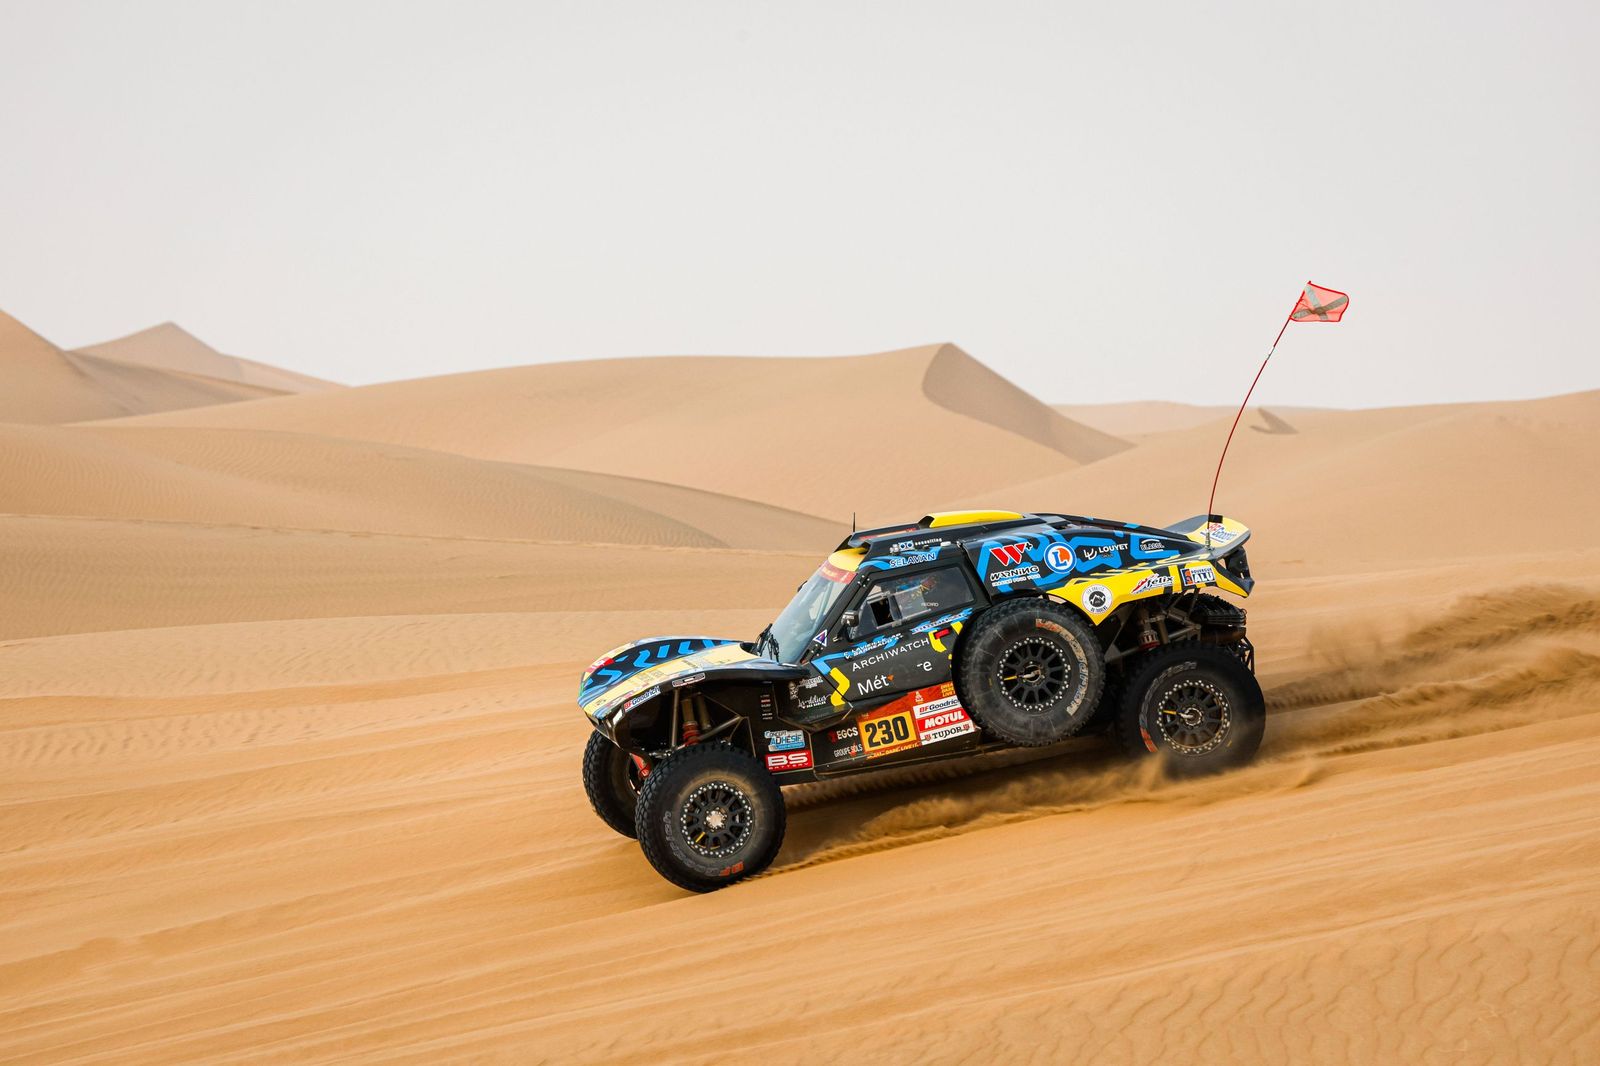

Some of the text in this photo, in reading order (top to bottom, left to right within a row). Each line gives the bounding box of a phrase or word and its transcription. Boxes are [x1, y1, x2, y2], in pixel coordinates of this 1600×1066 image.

[1098, 543, 1128, 553] LOUYET
[1193, 571, 1213, 583] ALU
[852, 637, 930, 672] ARCHIWATCH
[919, 698, 959, 714] BFGoodric
[924, 711, 964, 729] MOTUL
[836, 727, 859, 740] EGCS
[864, 715, 910, 748] 230
[932, 727, 962, 739] TUDOR
[833, 747, 850, 757] GROUPE
[767, 752, 808, 767] BS
